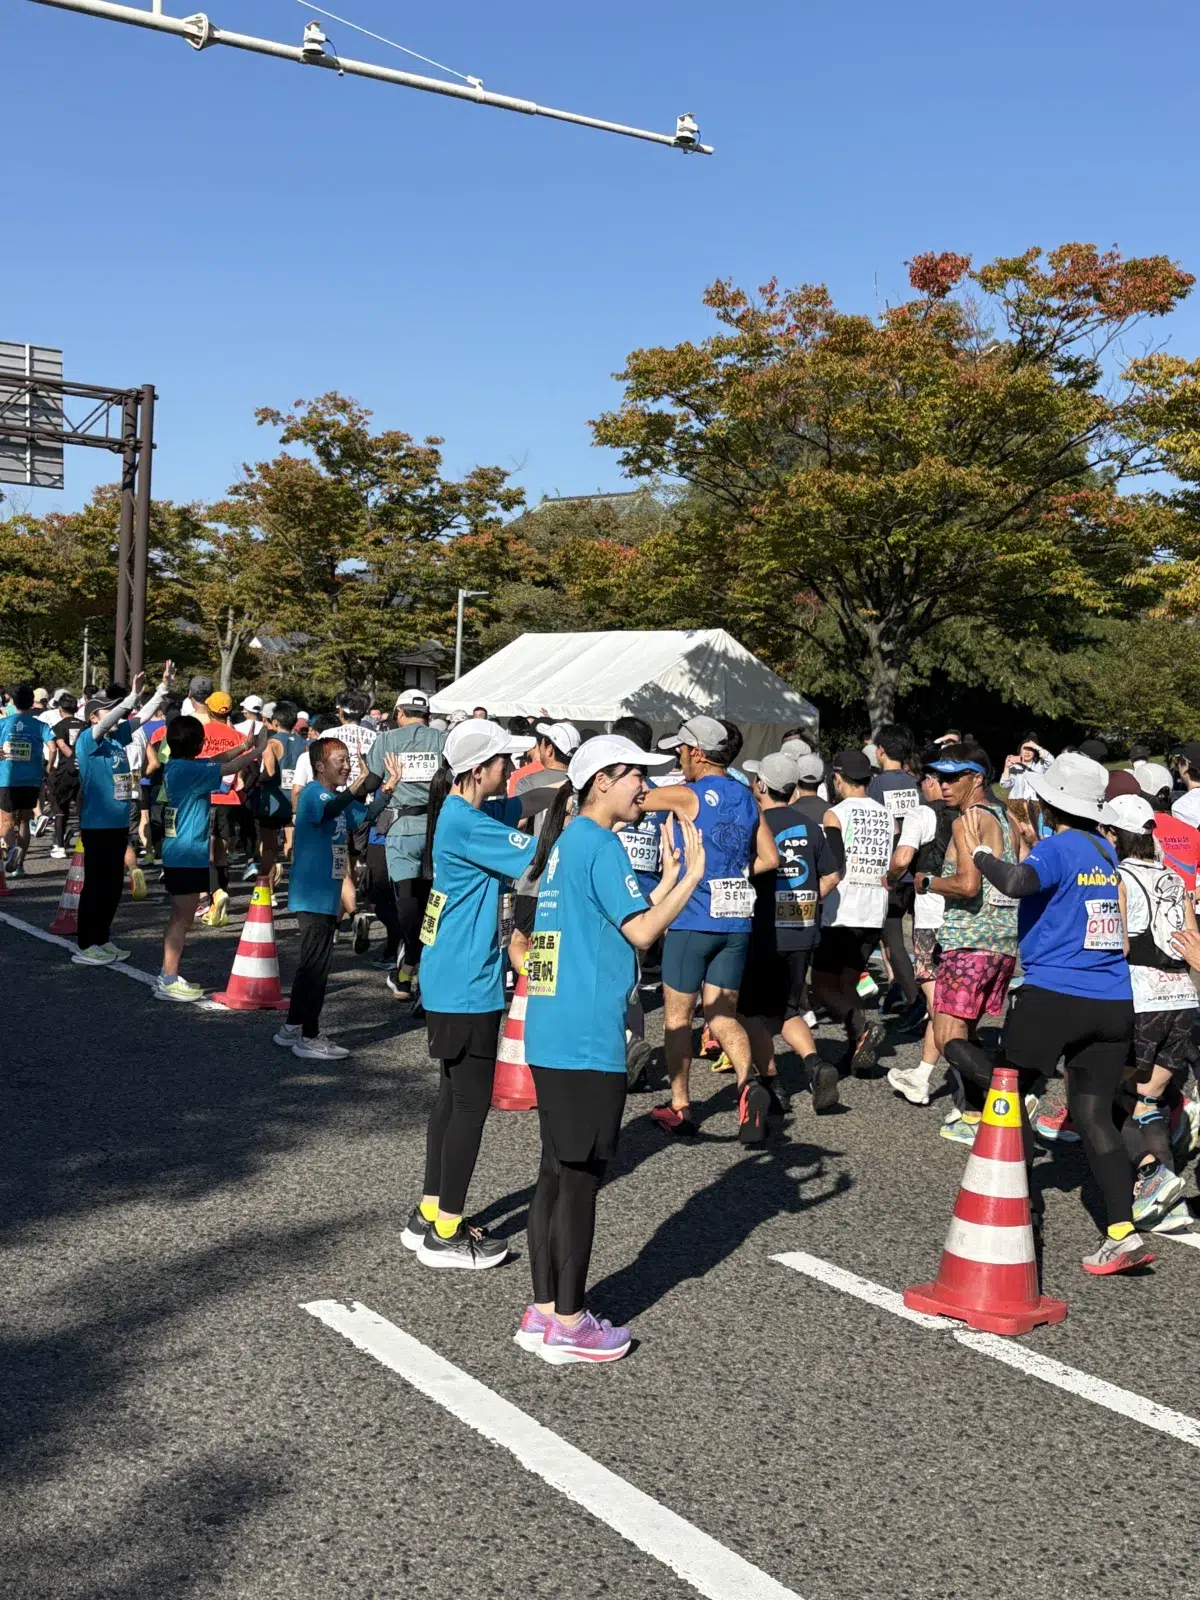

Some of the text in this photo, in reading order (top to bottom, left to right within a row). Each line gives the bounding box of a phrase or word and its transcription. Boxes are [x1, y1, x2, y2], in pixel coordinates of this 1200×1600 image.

[406, 753, 436, 761] サトウ食品
[896, 799, 916, 809] 1870
[724, 891, 746, 900] SEN
[789, 904, 813, 917] 3697
